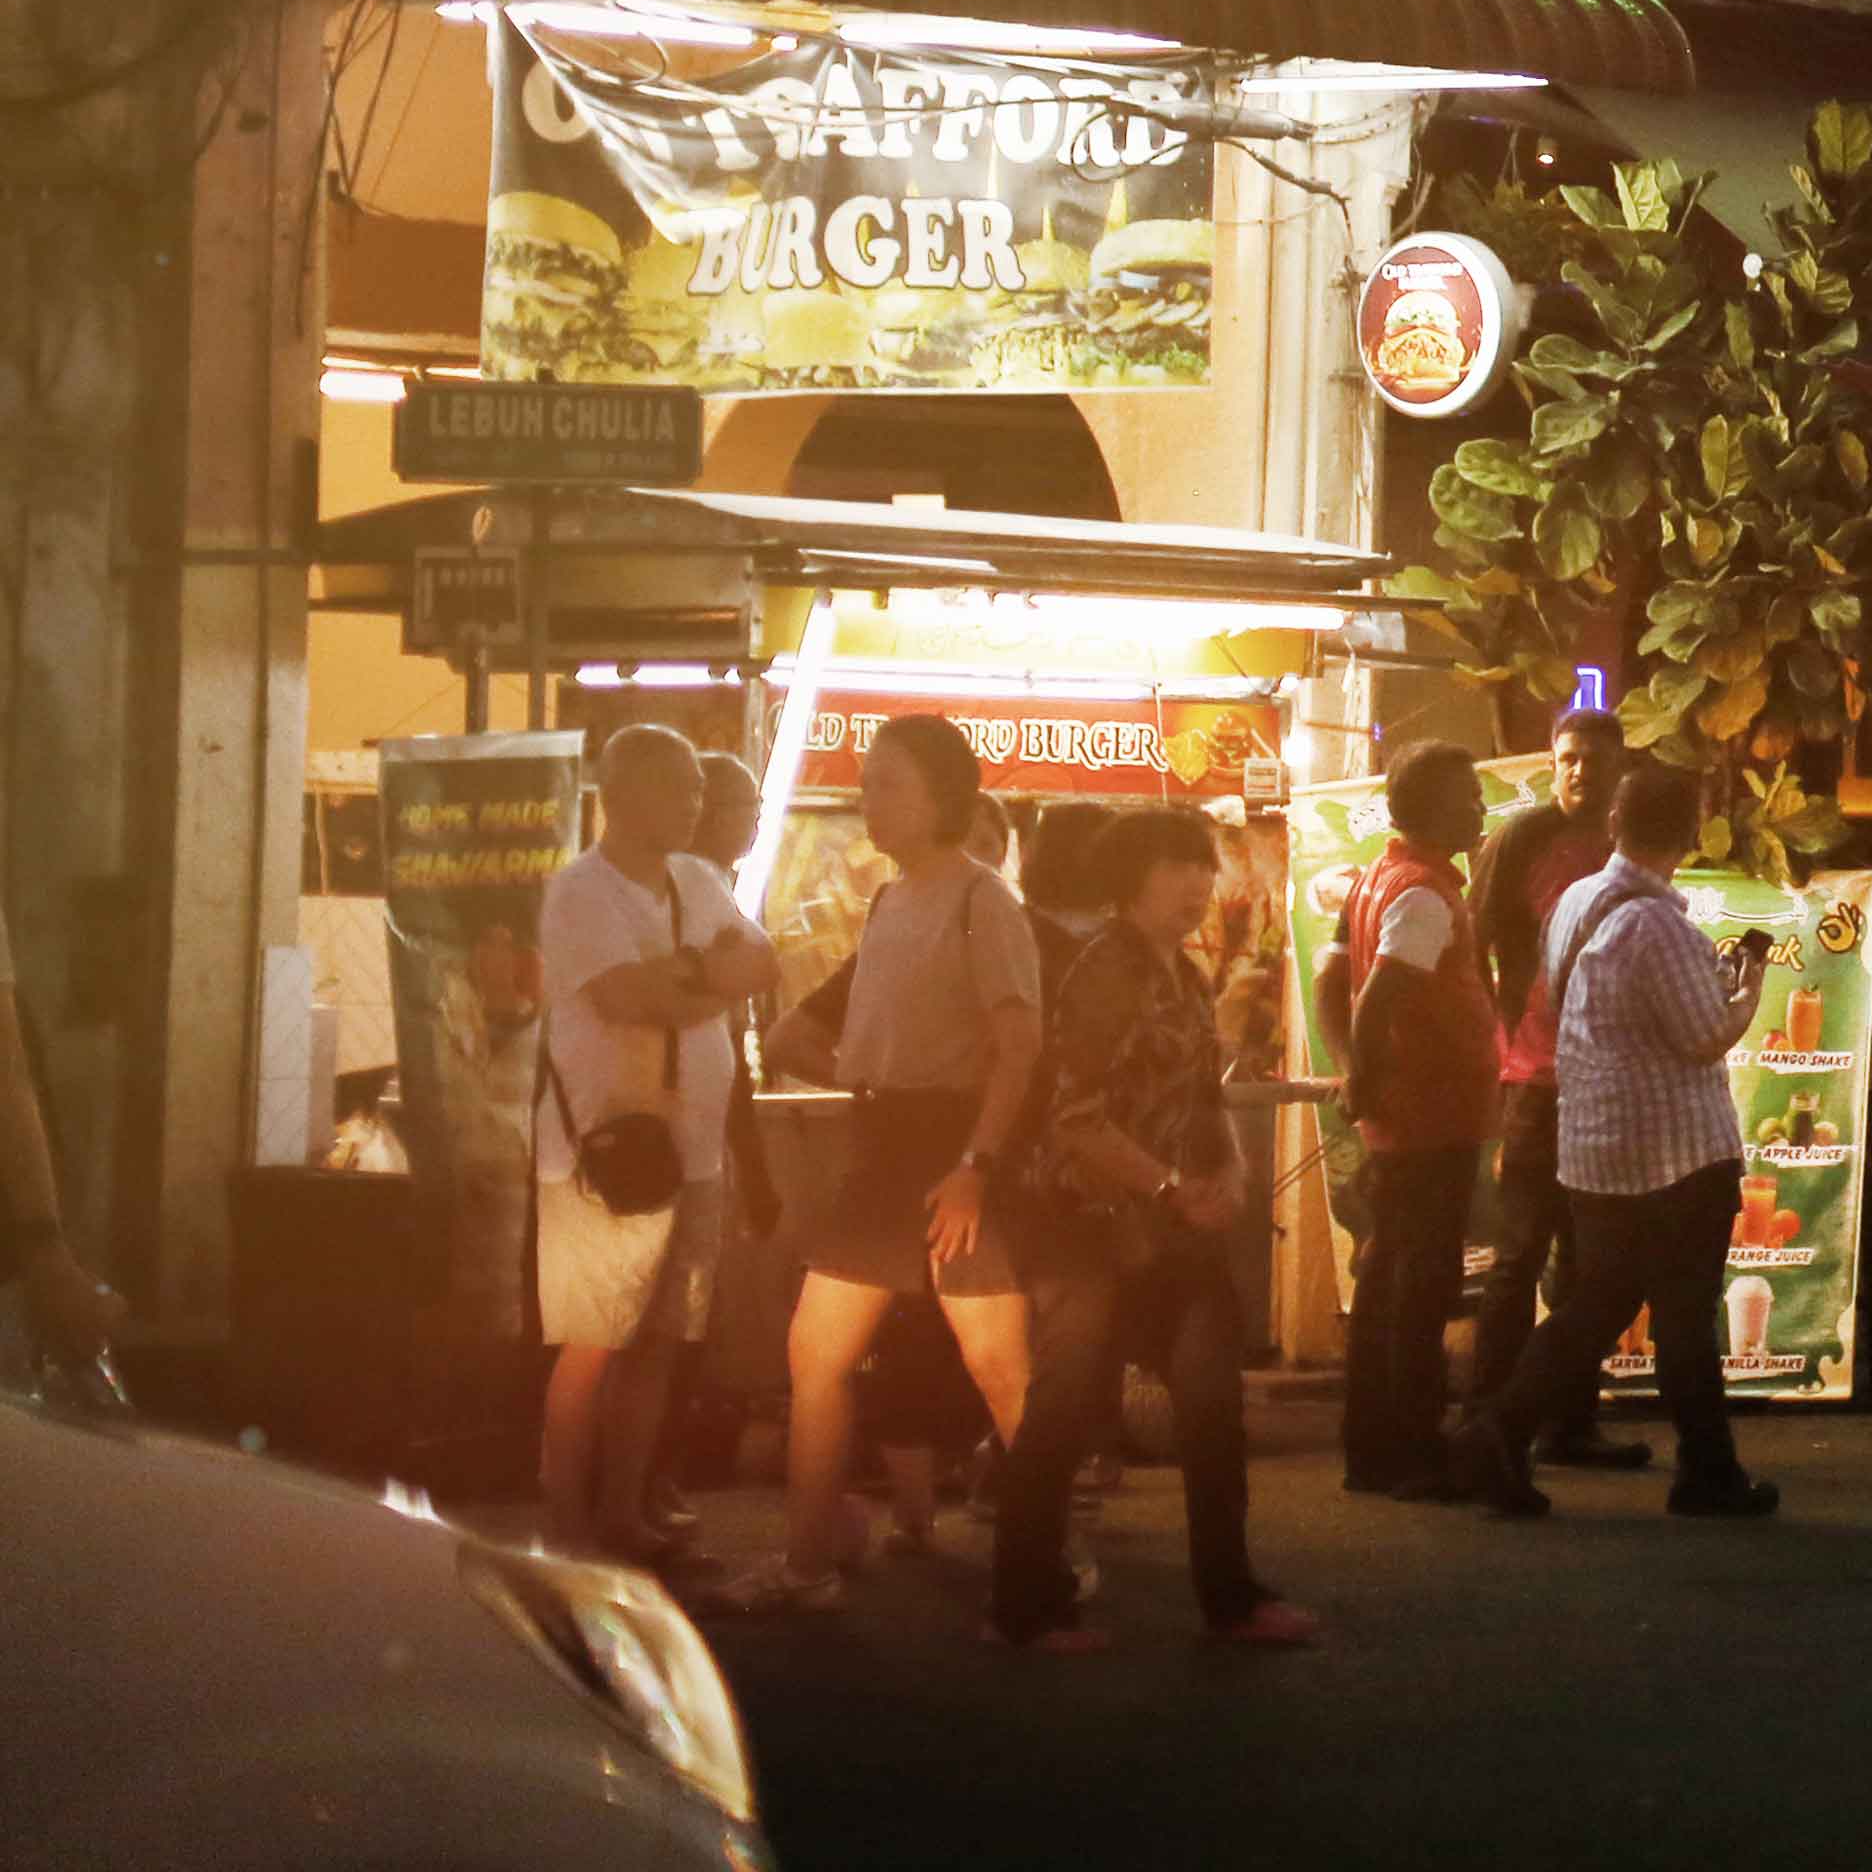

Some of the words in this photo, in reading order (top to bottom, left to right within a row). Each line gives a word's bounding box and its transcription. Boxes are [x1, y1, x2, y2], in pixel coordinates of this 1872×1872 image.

[687, 195, 1026, 296] BURGER
[429, 394, 544, 438] LEBUH
[552, 397, 676, 442] CHULIA
[1019, 719, 1169, 773] BURGER
[399, 801, 473, 829] HOME
[480, 800, 559, 827] MADE
[1759, 1051, 1806, 1066] MANGO
[1810, 1053, 1852, 1067] SHAKE
[1762, 1147, 1802, 1161] APPLE
[1805, 1147, 1843, 1161] JUICE
[1729, 1250, 1772, 1264] RANGE
[1775, 1250, 1812, 1263] JUICE
[1763, 1357, 1805, 1370] SHAKE
